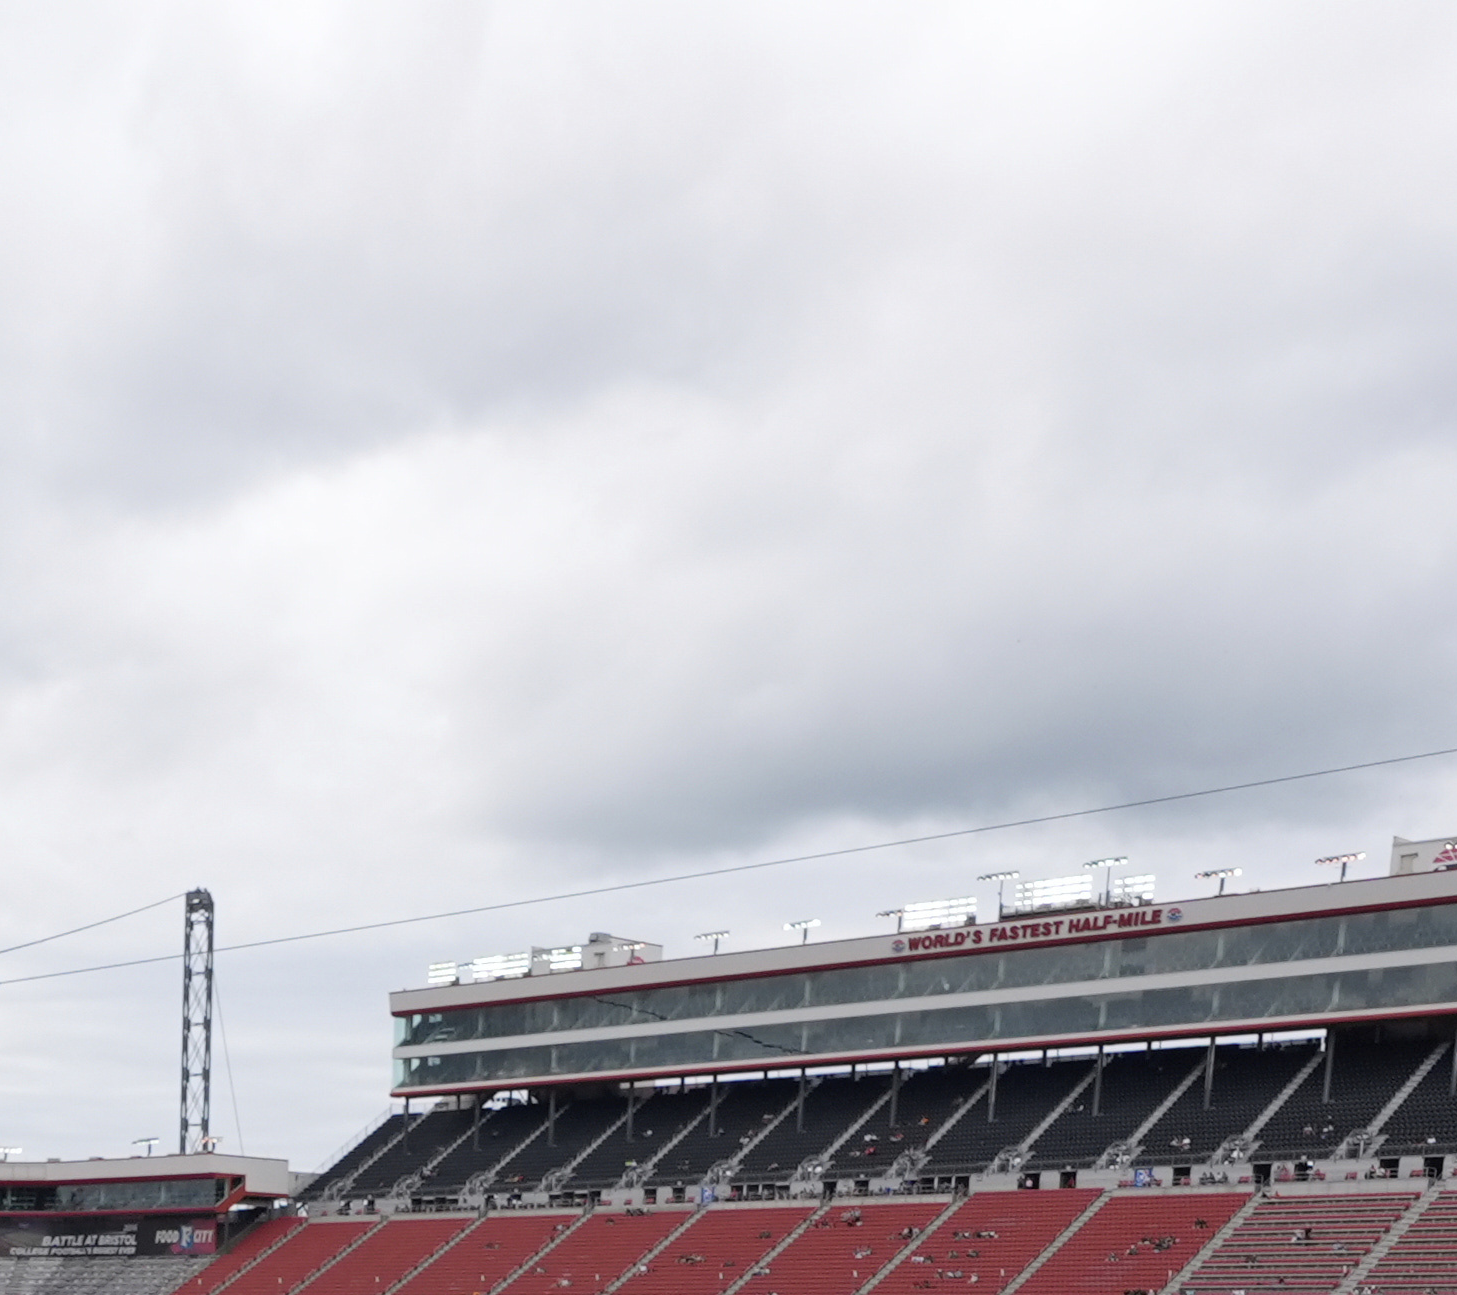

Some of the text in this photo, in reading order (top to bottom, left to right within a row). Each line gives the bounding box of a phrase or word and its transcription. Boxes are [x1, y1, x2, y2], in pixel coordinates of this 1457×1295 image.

[908, 909, 1163, 951] WORLD'S FASTEST HALF-MILE
[42, 1234, 137, 1247] BATTLE AT BRISTOL
[155, 1230, 180, 1244] FOOD
